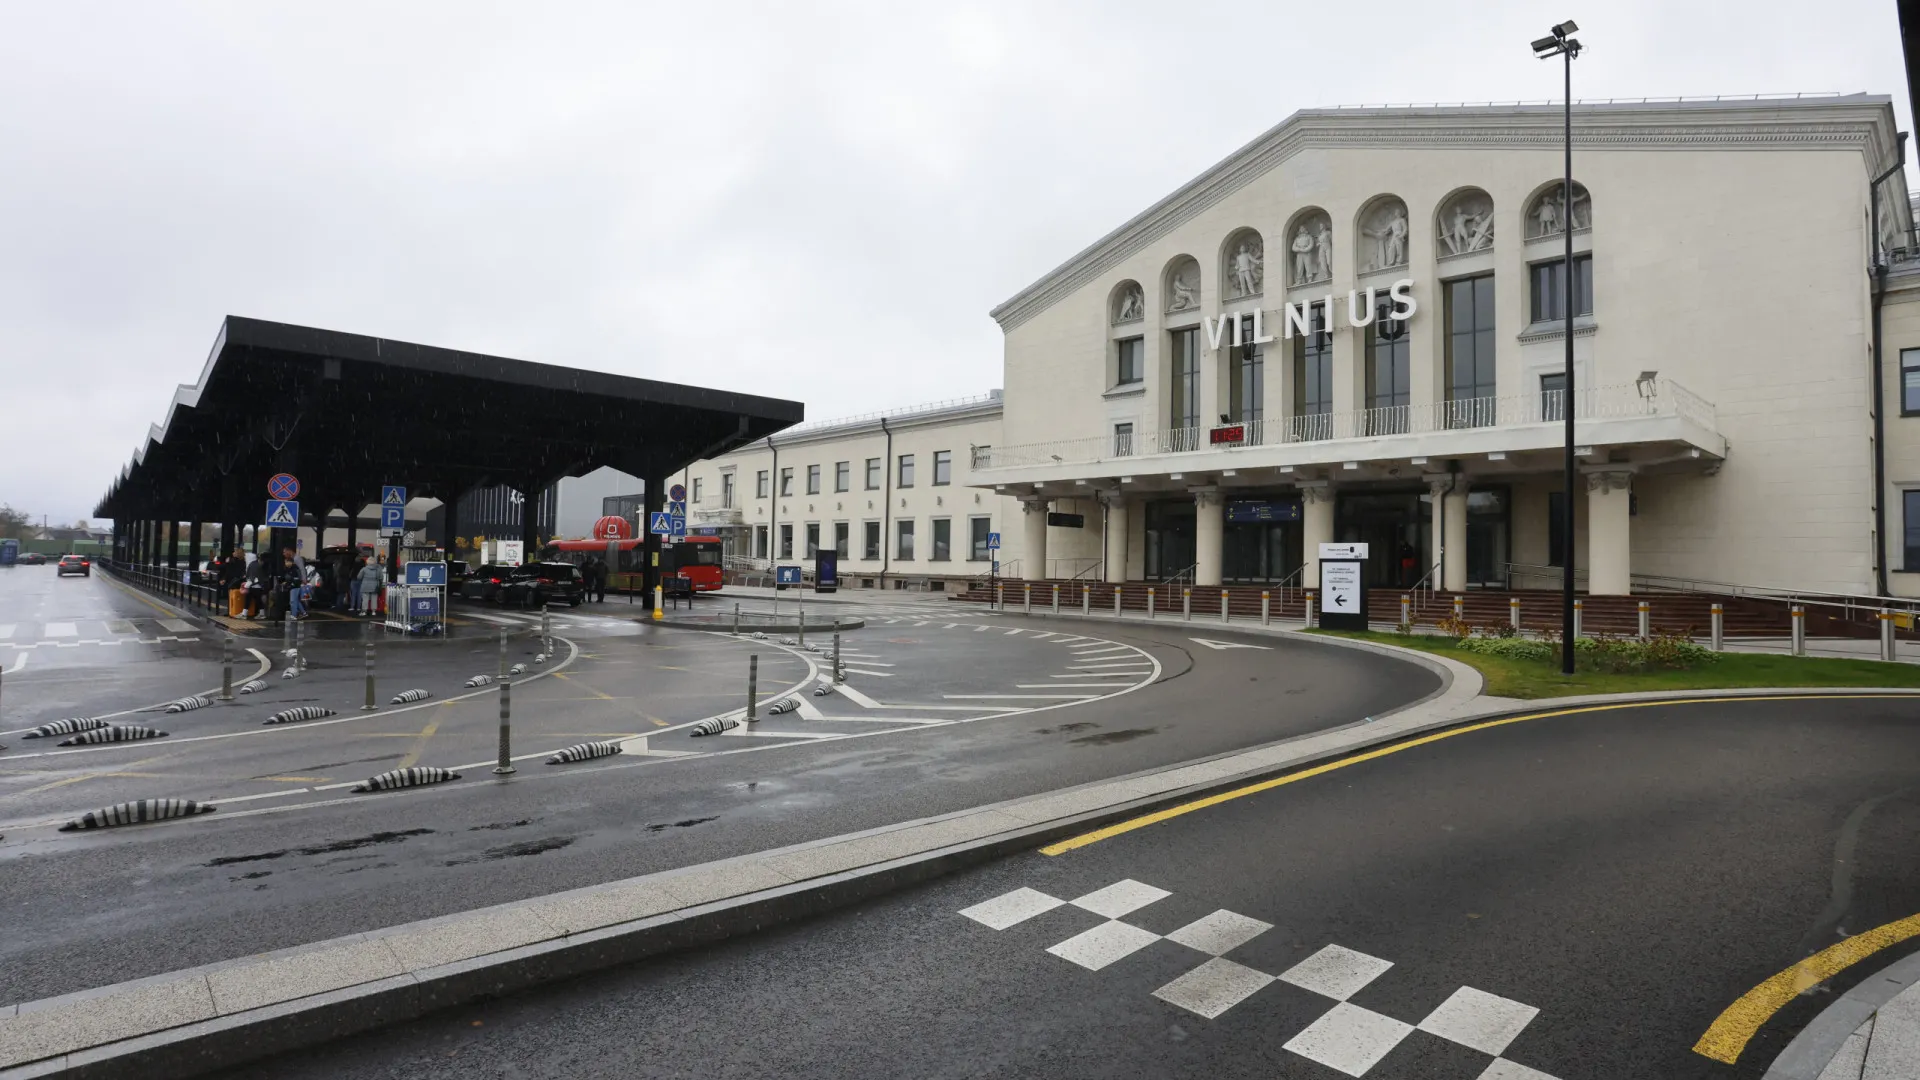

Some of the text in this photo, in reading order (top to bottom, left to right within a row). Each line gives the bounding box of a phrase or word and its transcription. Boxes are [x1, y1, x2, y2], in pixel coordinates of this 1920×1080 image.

[1204, 278, 1417, 350] VILNIUS
[387, 509, 401, 526] P
[673, 520, 683, 534] P
